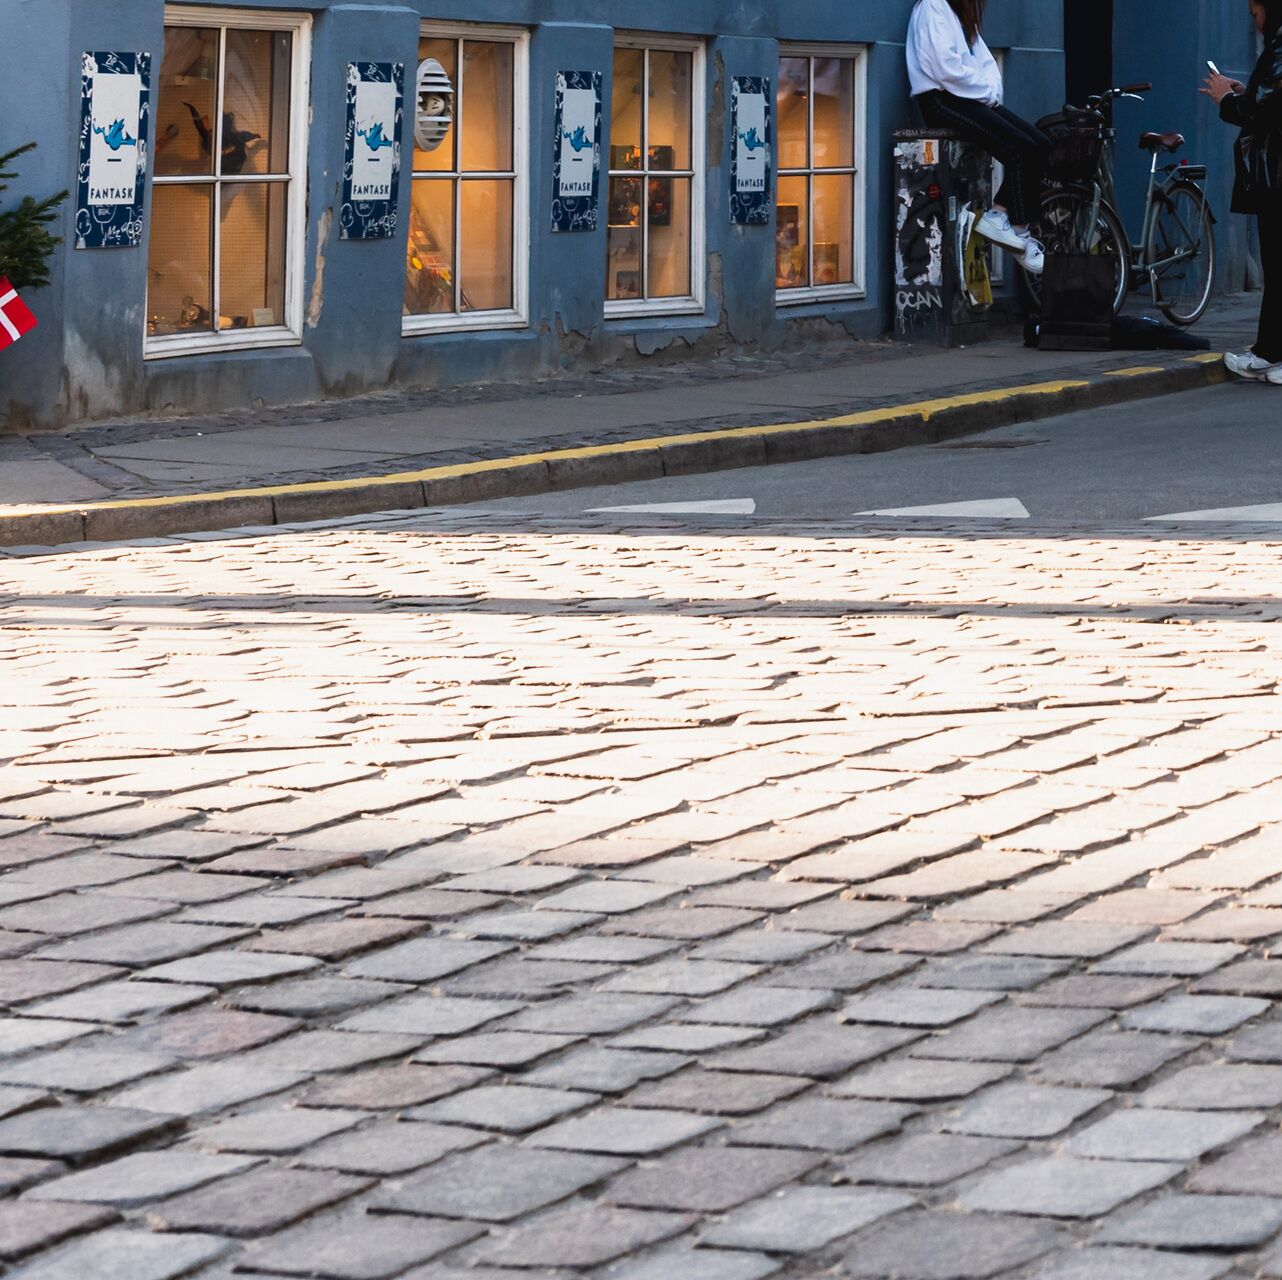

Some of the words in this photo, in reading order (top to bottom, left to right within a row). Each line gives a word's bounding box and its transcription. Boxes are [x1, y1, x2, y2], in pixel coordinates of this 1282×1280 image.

[561, 182, 591, 192] FANTASK
[738, 179, 764, 188] FANTASK
[90, 187, 133, 200] FANTASK
[353, 184, 390, 195] FANTASK
